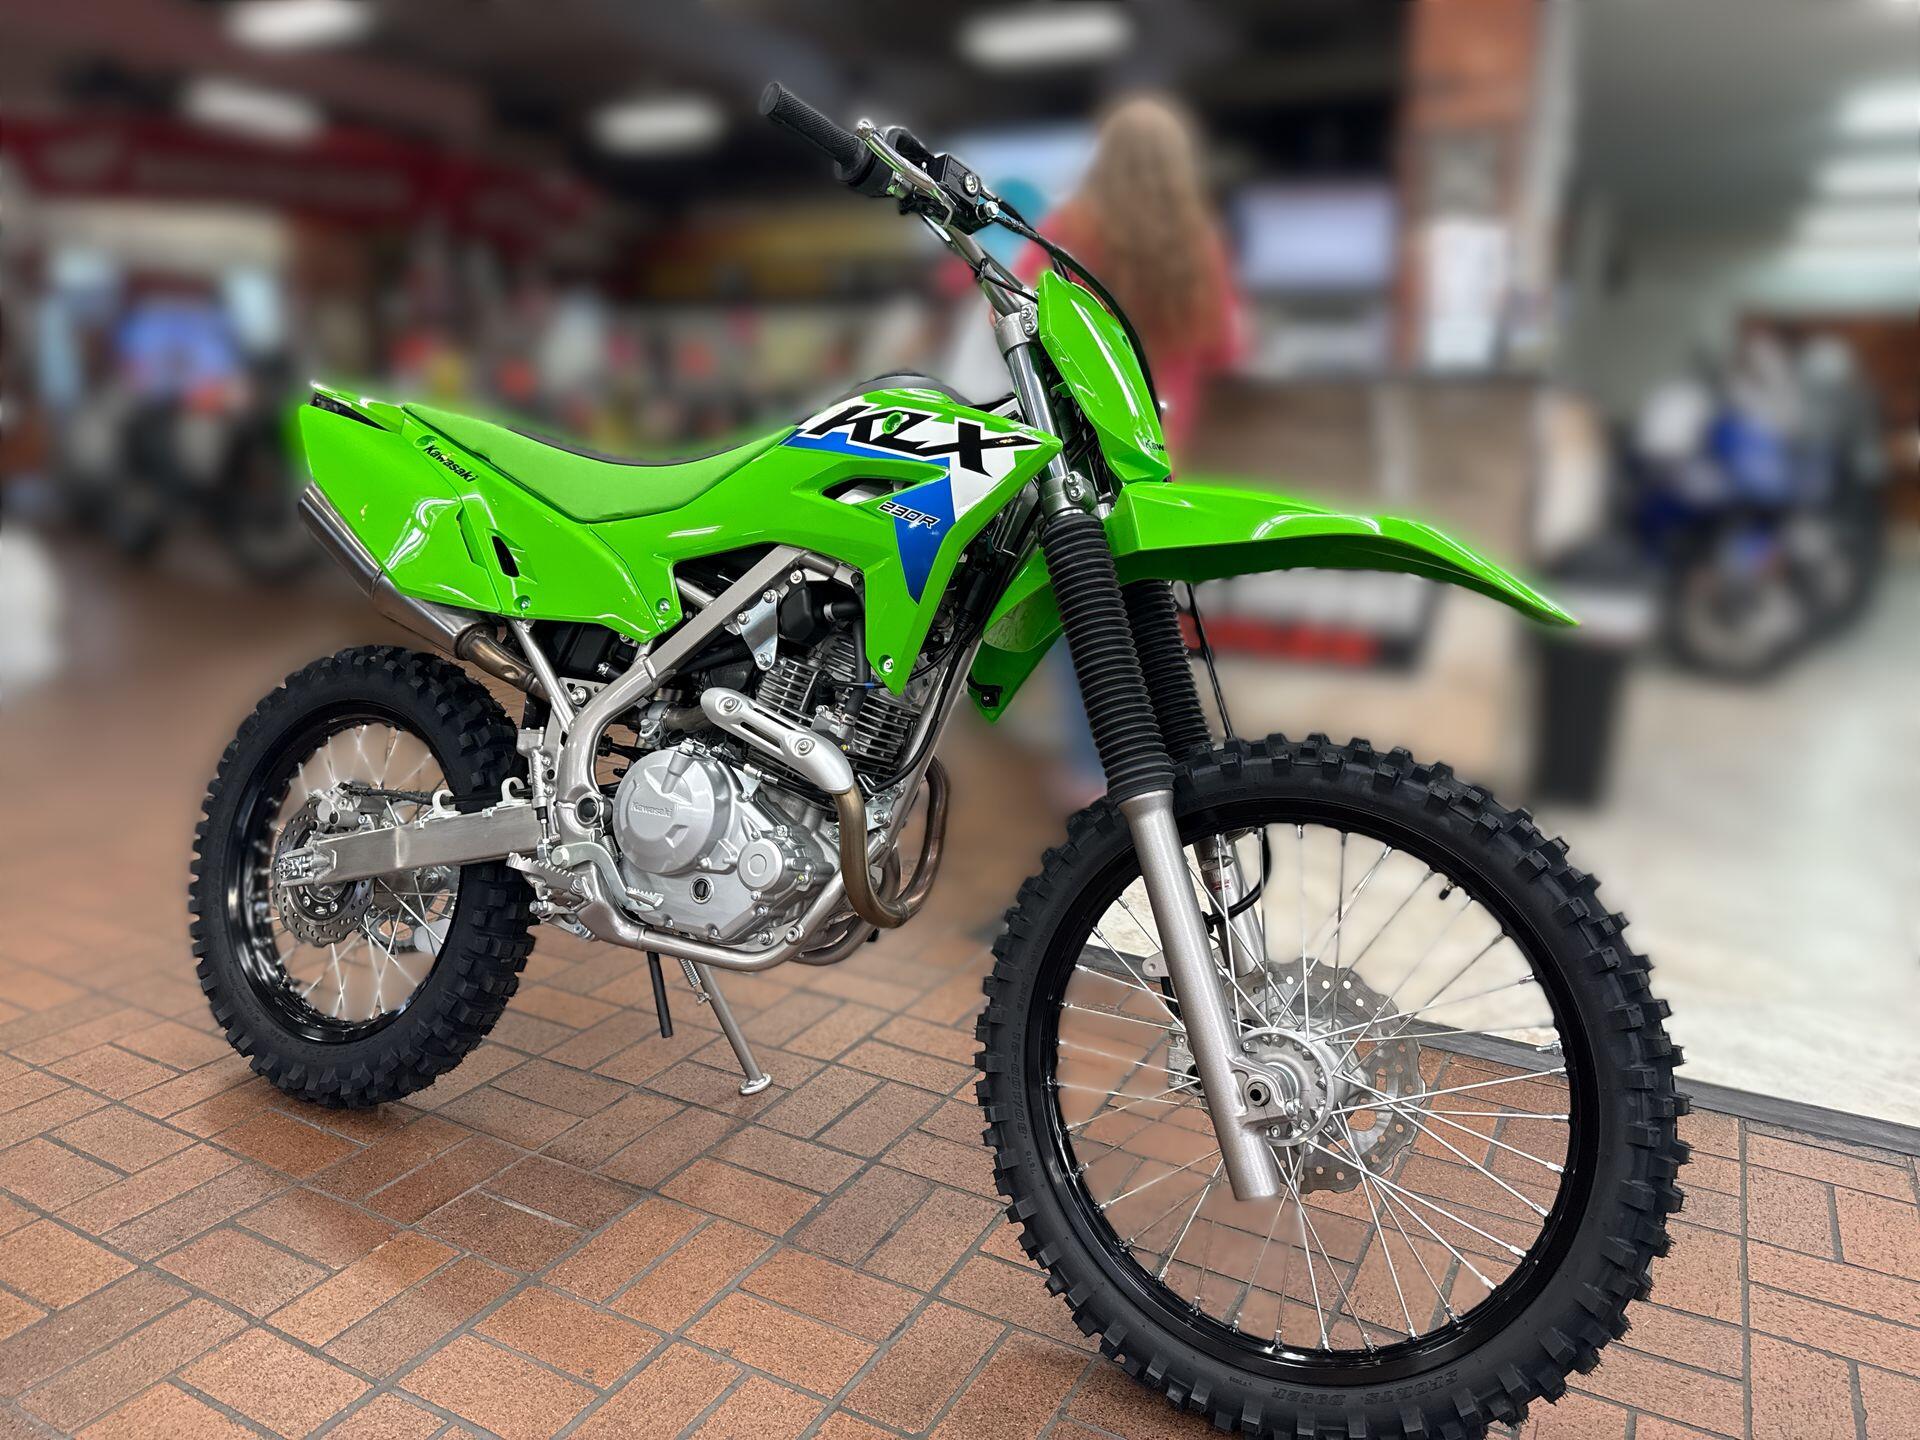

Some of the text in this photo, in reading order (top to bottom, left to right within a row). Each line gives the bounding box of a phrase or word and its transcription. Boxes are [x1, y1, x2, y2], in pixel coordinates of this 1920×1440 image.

[806, 404, 1043, 478] KLX
[423, 444, 479, 482] Kawasaki
[878, 500, 941, 529] 230R
[631, 801, 673, 819] Kawasaki
